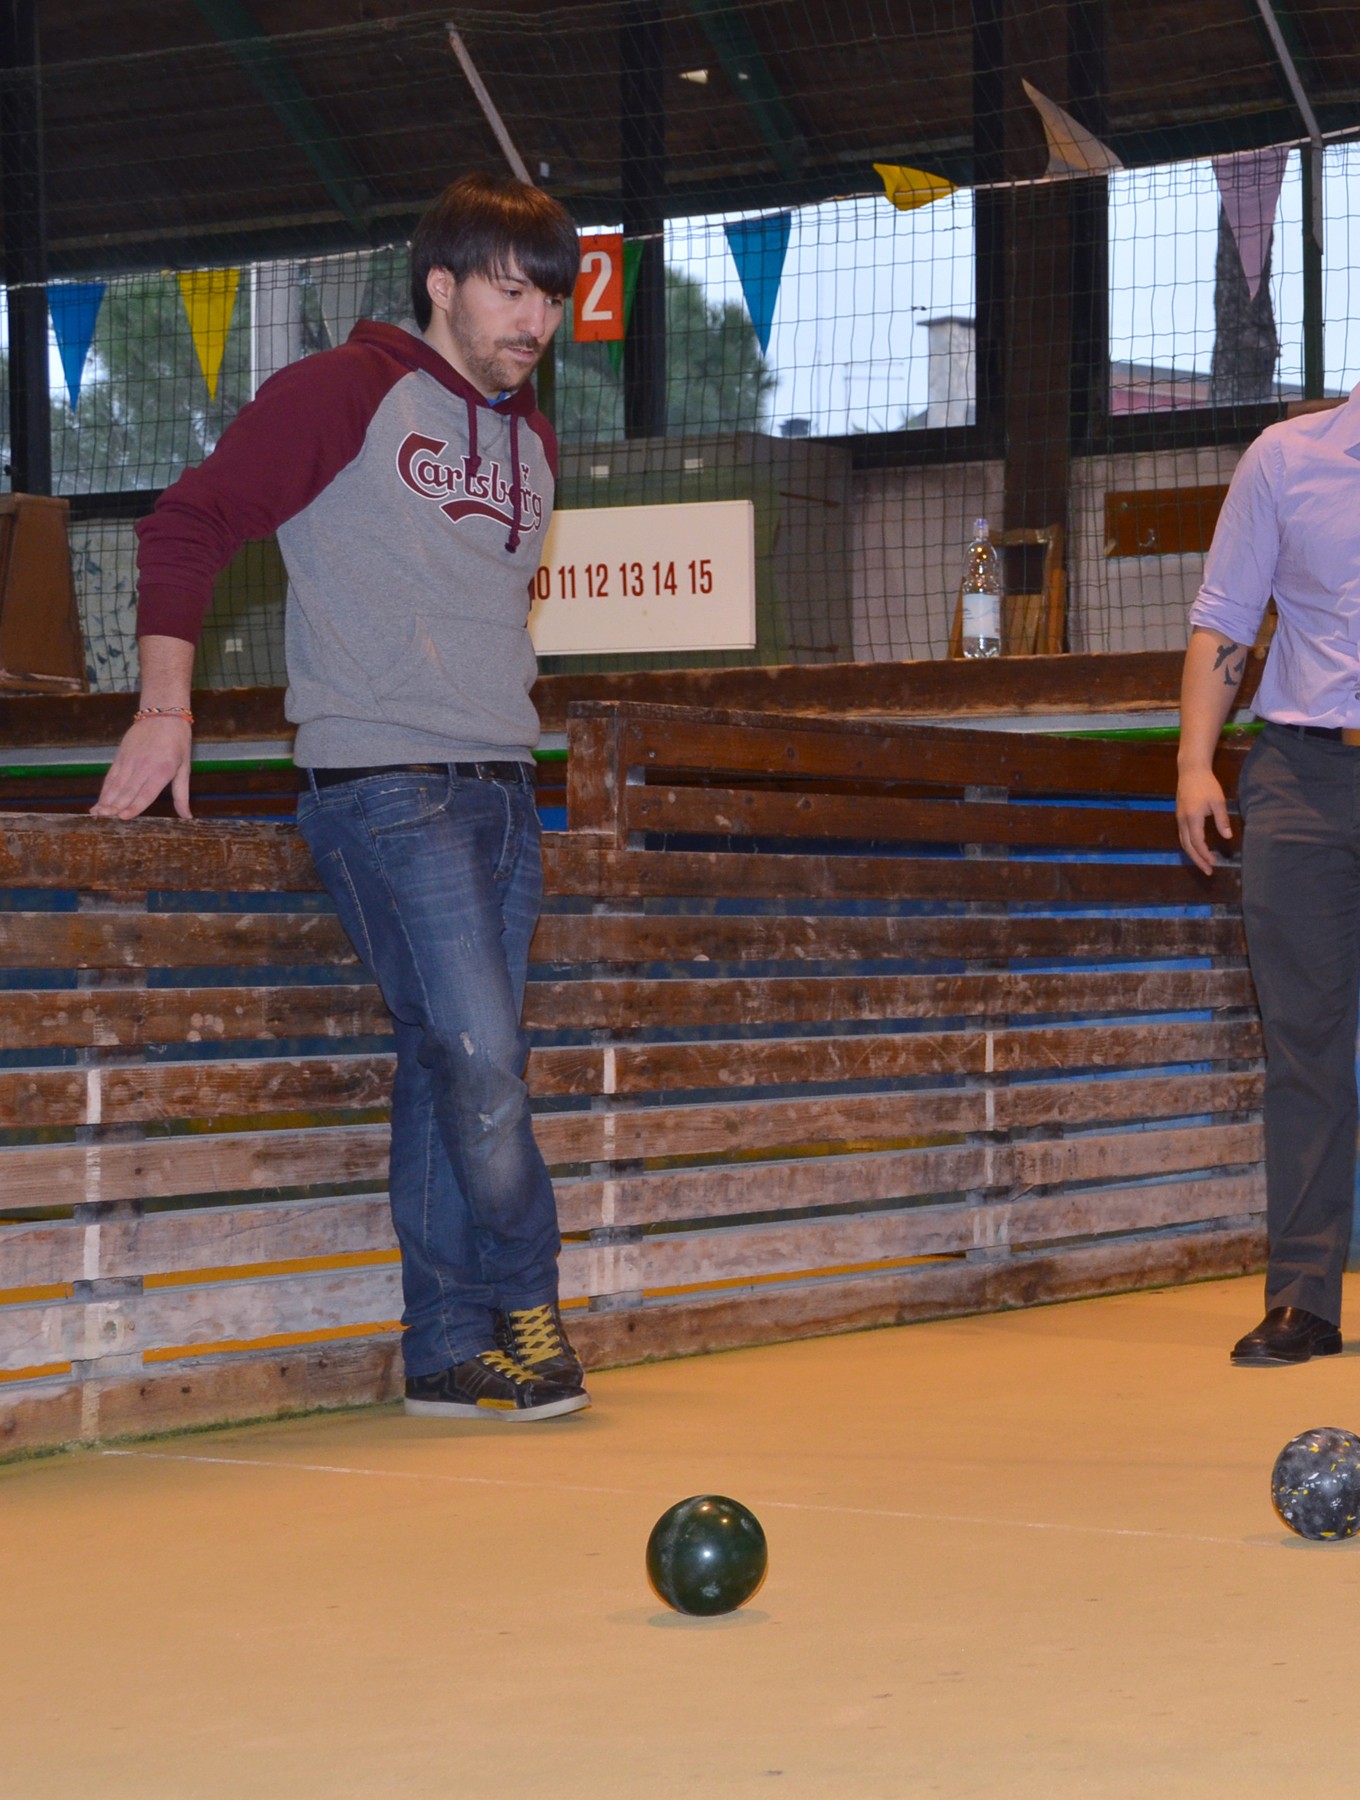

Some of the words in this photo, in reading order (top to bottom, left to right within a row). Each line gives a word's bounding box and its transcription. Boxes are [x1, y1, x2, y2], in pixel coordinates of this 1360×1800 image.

[581, 251, 613, 322] 2
[558, 564, 576, 599] 11
[584, 563, 609, 598] 12
[619, 562, 644, 597] 13
[652, 561, 678, 596] 14
[688, 559, 713, 594] 15
